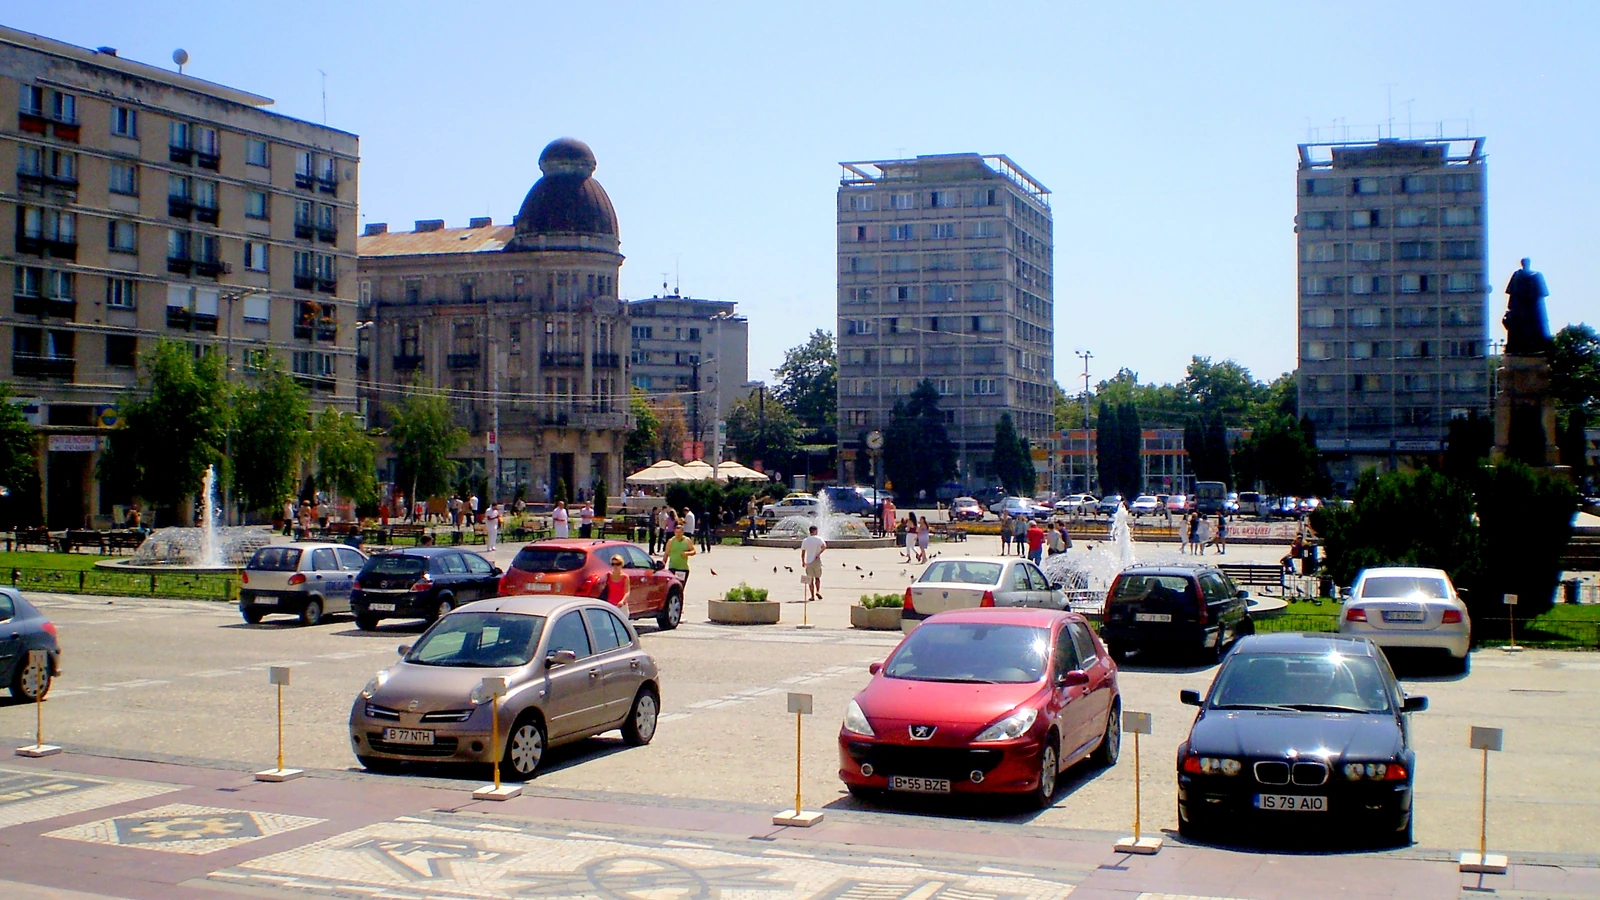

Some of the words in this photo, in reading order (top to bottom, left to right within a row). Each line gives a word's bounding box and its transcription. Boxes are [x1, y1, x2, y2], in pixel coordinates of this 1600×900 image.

[390, 729, 396, 740] B
[399, 730, 409, 740] 77
[411, 731, 430, 742] NTH
[895, 777, 903, 788] B
[908, 778, 920, 789] 55
[924, 779, 948, 791] BZE
[1263, 796, 1275, 808] IS
[1280, 797, 1295, 809] 79
[1300, 798, 1322, 810] AIO
